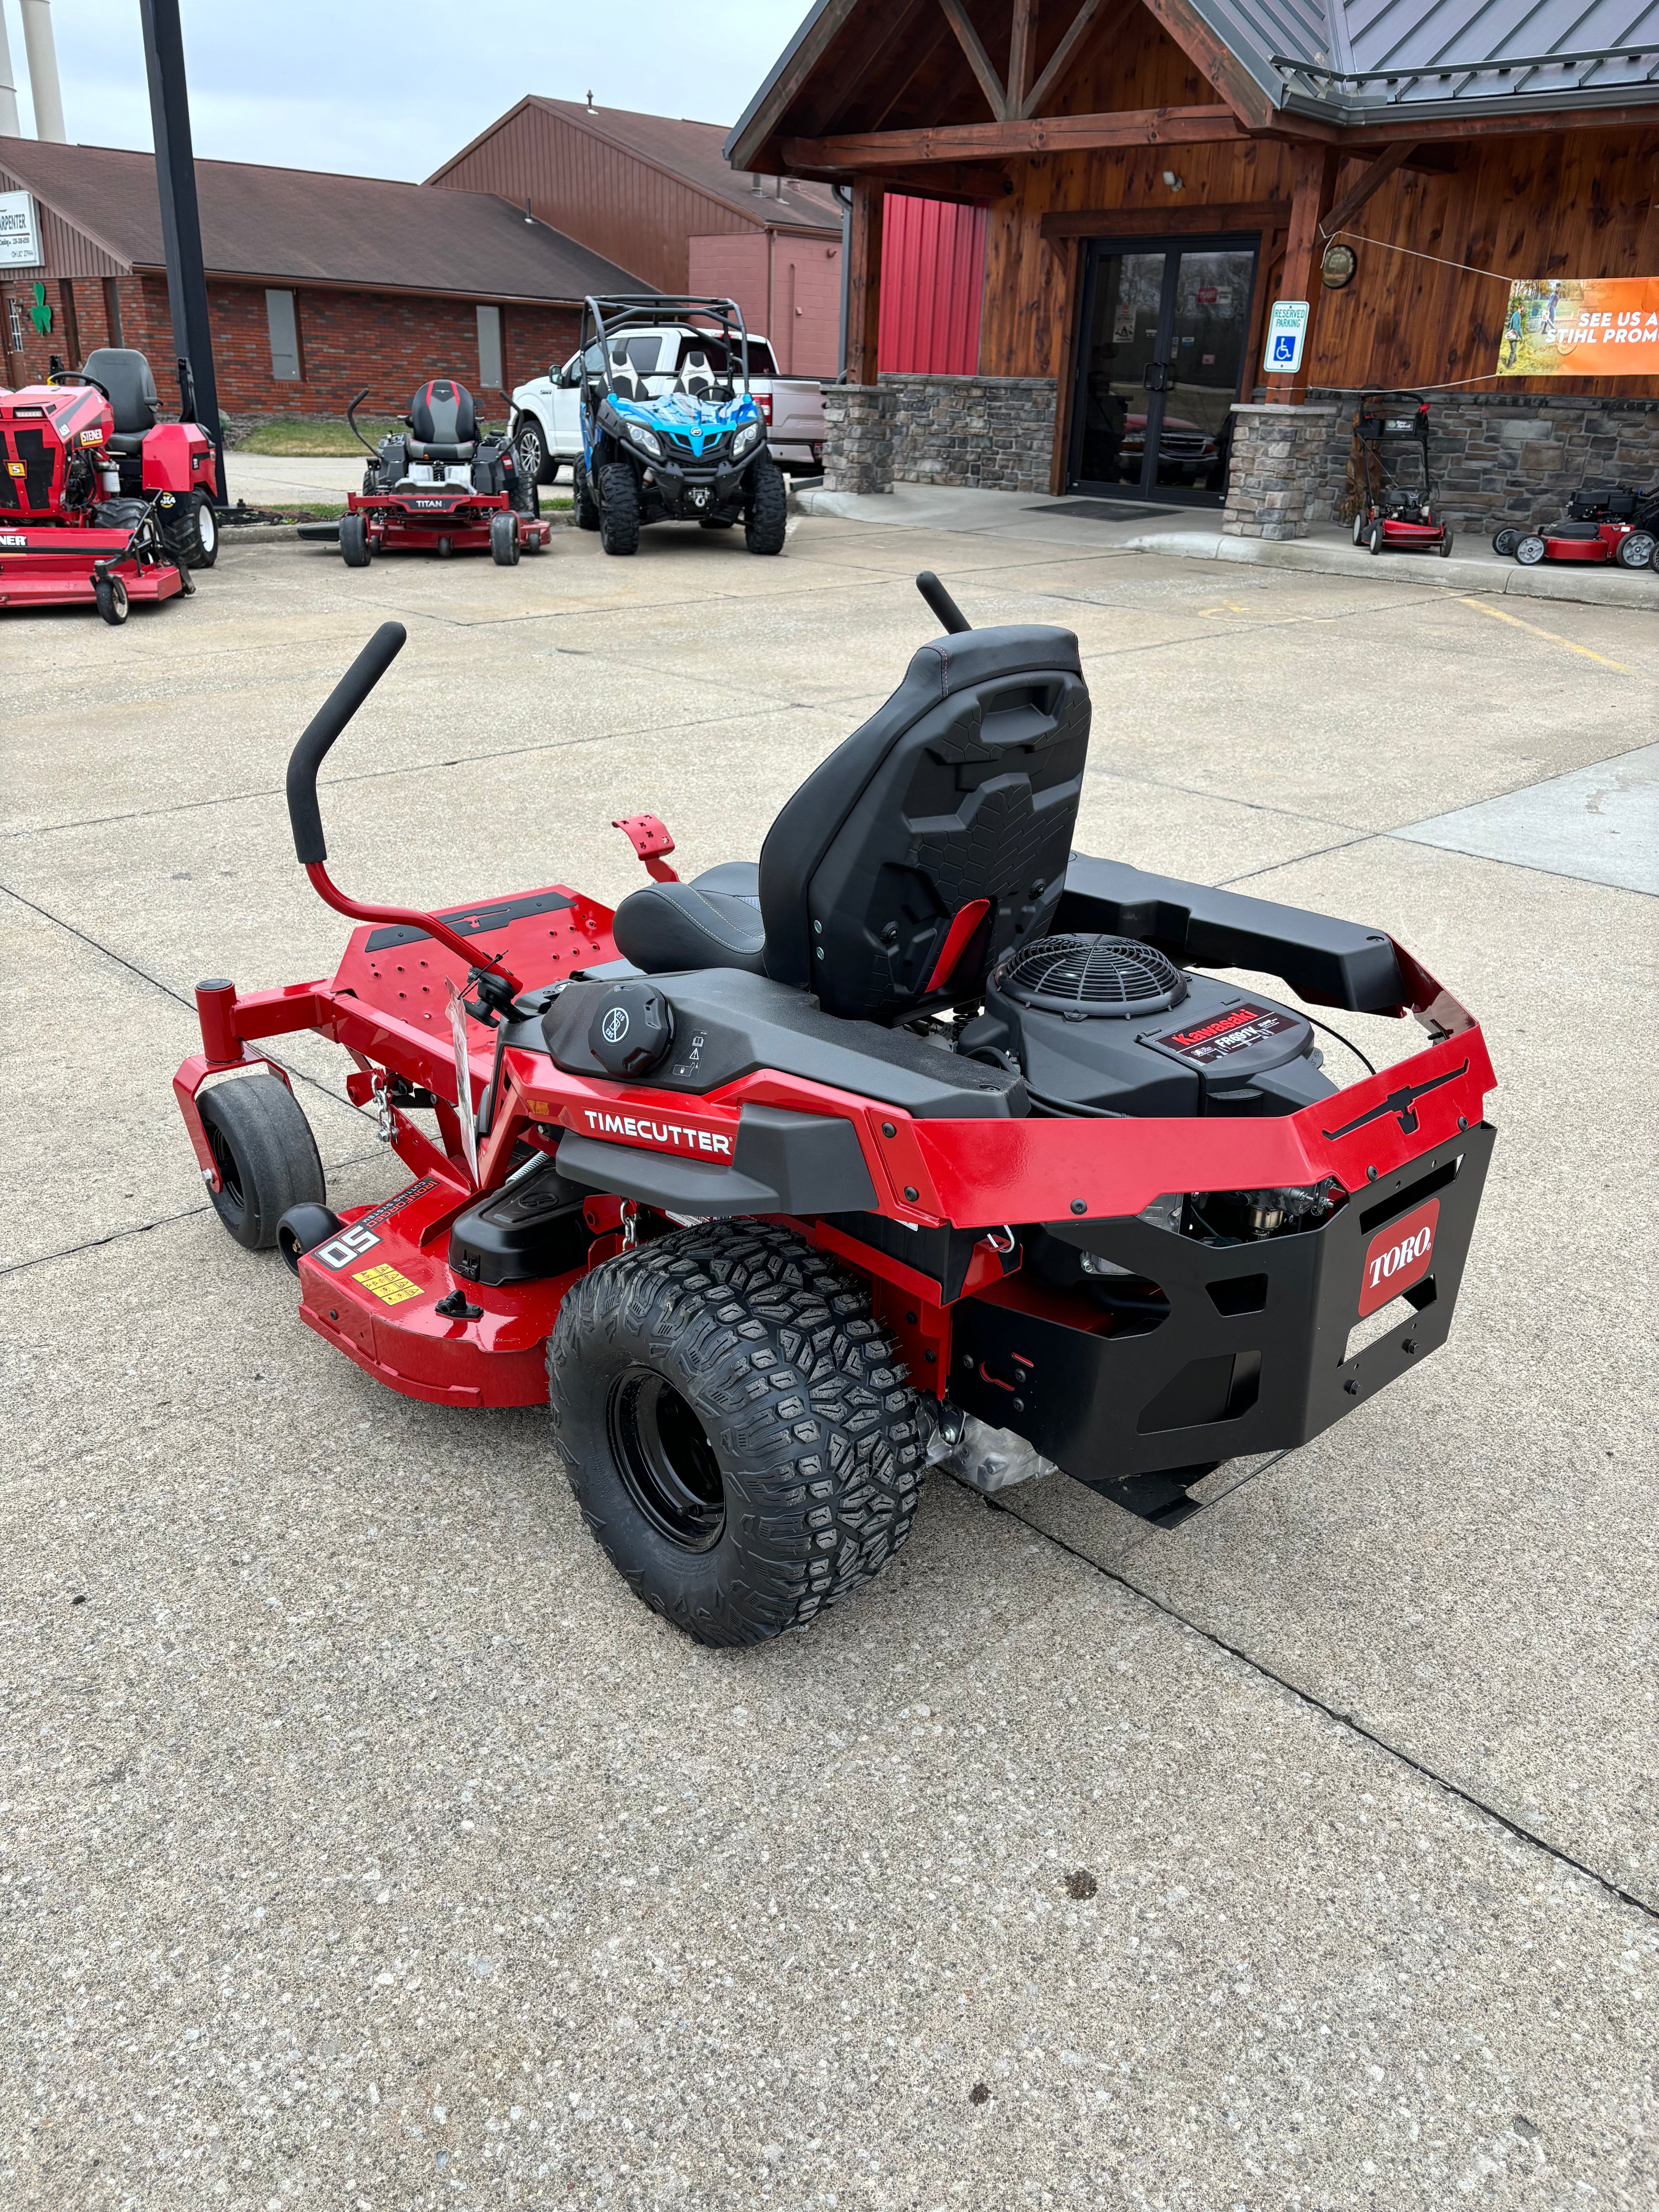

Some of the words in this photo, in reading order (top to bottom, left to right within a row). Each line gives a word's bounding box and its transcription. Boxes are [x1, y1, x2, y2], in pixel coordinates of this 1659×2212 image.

[1274, 309, 1305, 318] RESERVED
[1578, 312, 1613, 327] SEE
[1617, 311, 1641, 326] US
[1276, 318, 1301, 328] PARKING
[1545, 329, 1597, 343] STIHL
[1603, 328, 1659, 343] PROM
[12, 465, 21, 473] S
[616, 1011, 625, 1021] E15
[605, 1028, 614, 1038] E85
[1171, 1008, 1259, 1046] Kawasaki
[1214, 1026, 1258, 1046] FR691V
[584, 1110, 732, 1156] TIMECUTTER
[393, 1182, 426, 1202] CUTTING
[362, 1203, 393, 1223] SYSTEM
[366, 1181, 438, 1228] IRONFORGED
[1369, 1226, 1431, 1288] TORO
